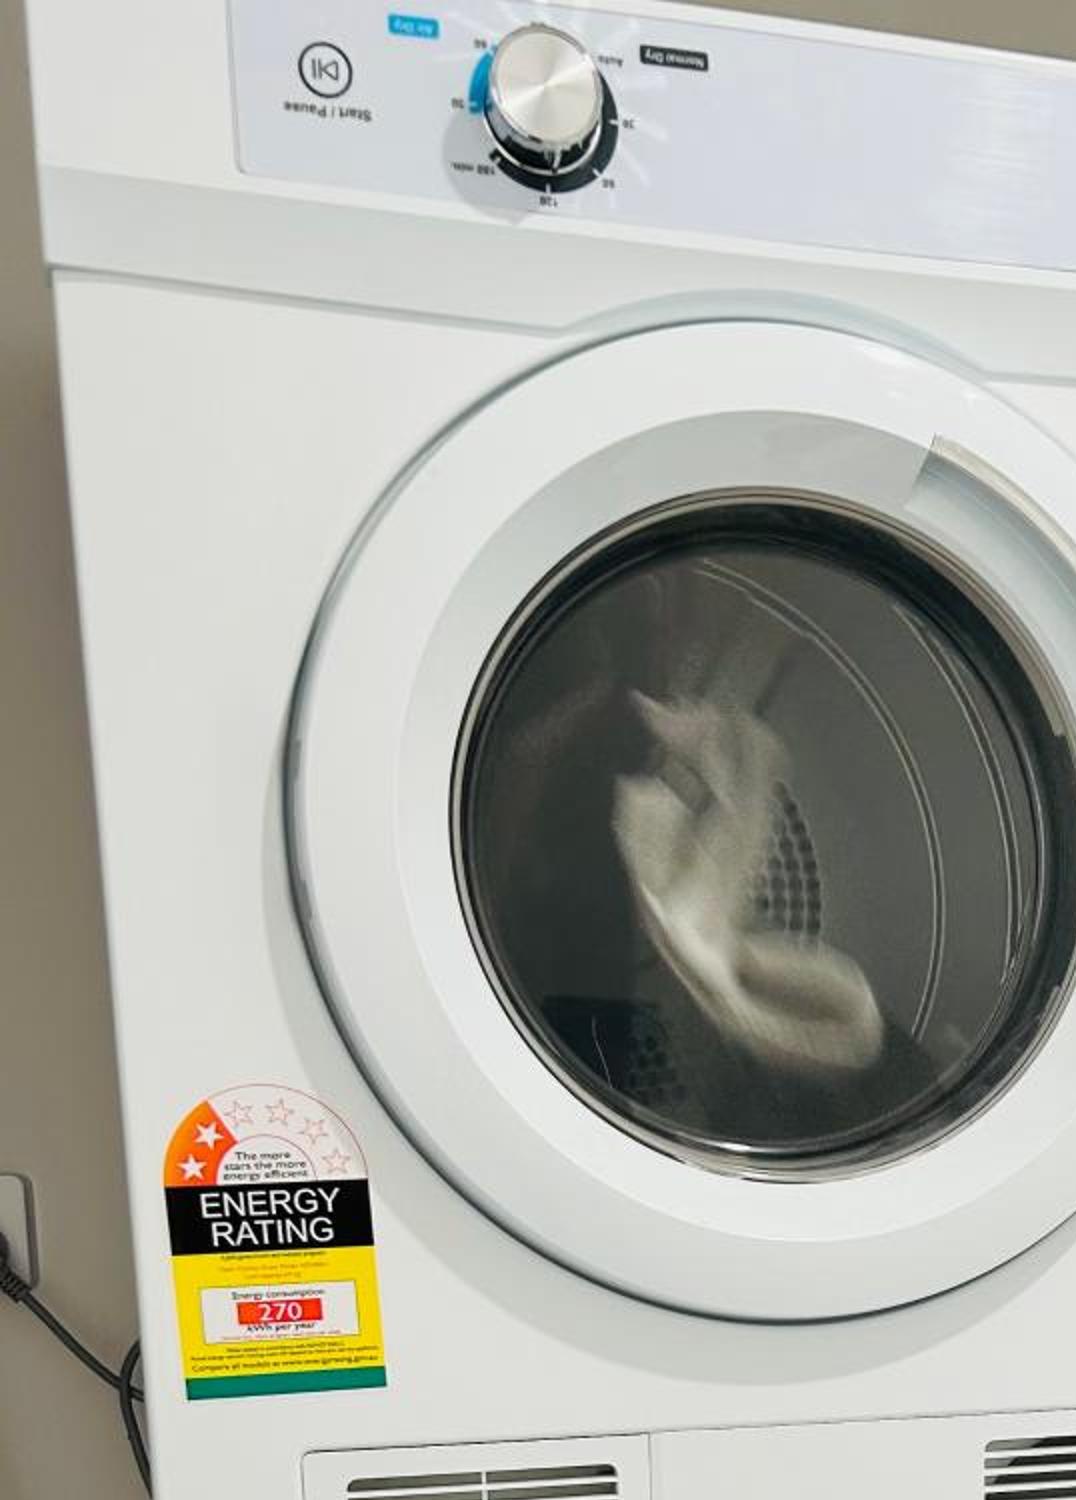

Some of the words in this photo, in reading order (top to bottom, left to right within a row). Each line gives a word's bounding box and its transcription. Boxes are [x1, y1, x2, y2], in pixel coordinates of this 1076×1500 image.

[643, 48, 665, 64] Dry
[665, 53, 705, 69] Normal
[283, 101, 327, 119] Pause
[339, 105, 373, 122] Start
[235, 1151, 257, 1161] The
[260, 1151, 291, 1160] more
[224, 1163, 250, 1172] stars
[253, 1161, 273, 1170] the
[275, 1160, 307, 1170] more
[223, 1171, 261, 1182] energy
[265, 1169, 309, 1179] efficient
[200, 1187, 341, 1219] ENERGY
[211, 1216, 335, 1247] RATING
[231, 1290, 264, 1302] Energy
[266, 1288, 326, 1300] consumption
[257, 1301, 304, 1322] 270
[274, 1323, 293, 1333] per
[295, 1322, 316, 1332] year
